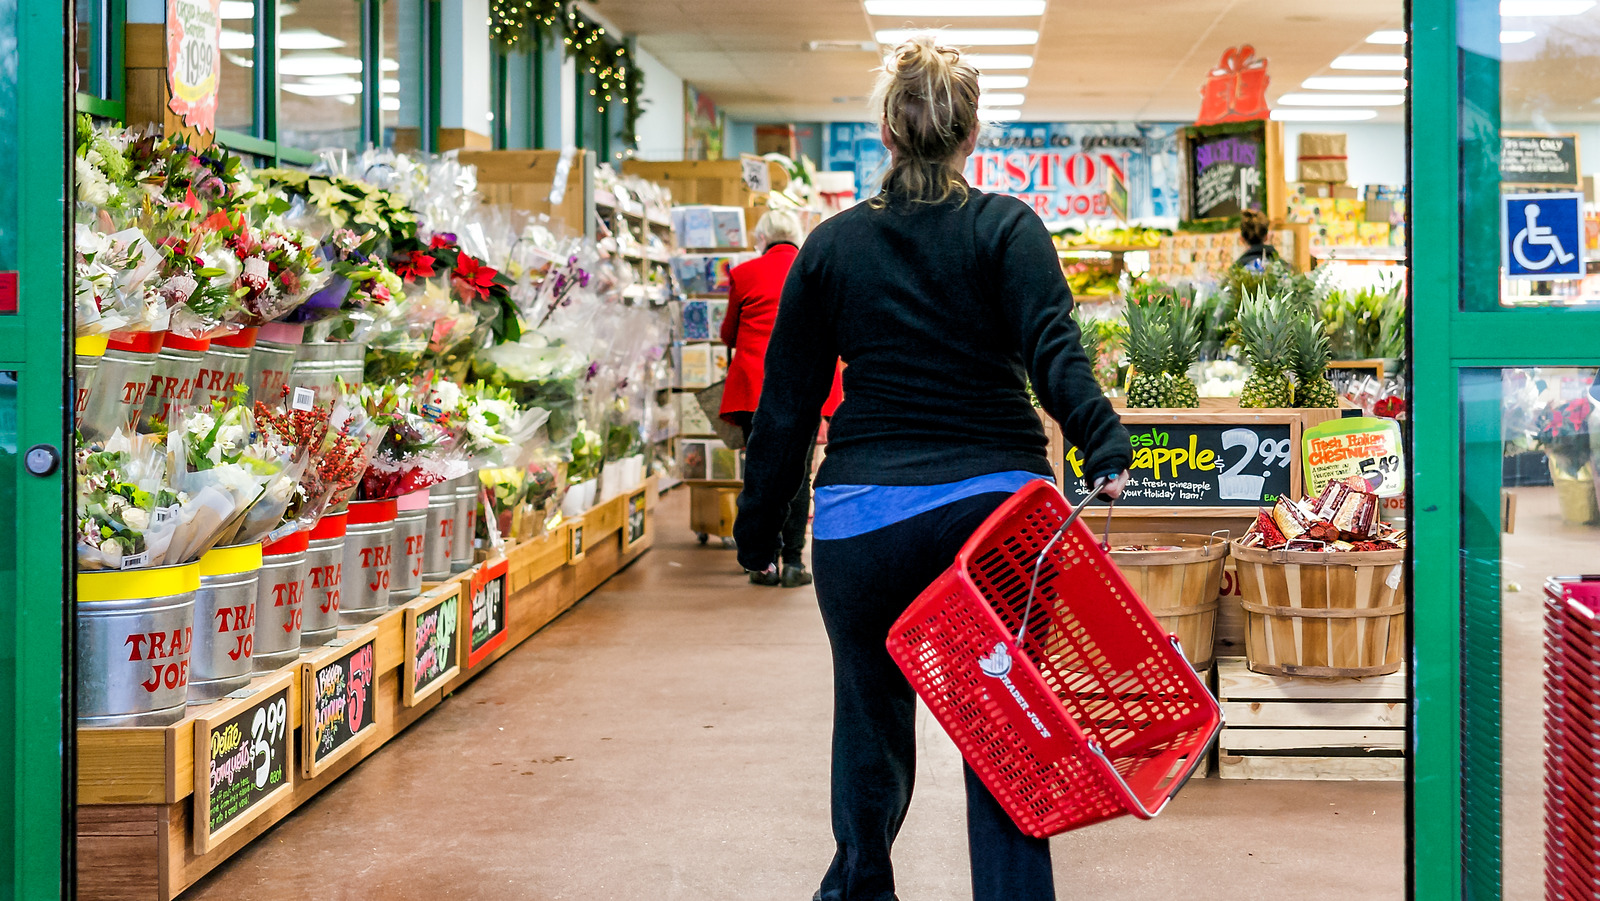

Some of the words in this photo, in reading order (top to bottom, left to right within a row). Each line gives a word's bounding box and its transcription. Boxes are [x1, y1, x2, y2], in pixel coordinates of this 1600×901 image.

[973, 152, 1130, 191] ESTON
[1057, 194, 1109, 217] JOE
[147, 375, 196, 399] TRA
[195, 368, 243, 391] TRA
[1129, 428, 1169, 446] esh
[1310, 437, 1342, 452] Fresh
[1309, 445, 1388, 466] CHESTNUTS
[1075, 487, 1091, 495] slic
[1122, 491, 1142, 500] your
[1143, 488, 1175, 500] Holiday
[1179, 489, 1204, 500] ham!
[1125, 478, 1139, 486] ats
[1142, 477, 1167, 488] fresh
[1169, 481, 1211, 493] pineapple
[1264, 493, 1279, 502] EAC
[1383, 498, 1405, 509] JOE
[358, 544, 391, 568] TRA
[308, 563, 342, 589] TRA
[272, 580, 304, 607] TRA
[214, 603, 256, 633] TRA
[124, 626, 193, 661] TRAD
[1000, 674, 1030, 711] TRADER
[1027, 710, 1051, 738] JOE'S
[211, 722, 242, 760] Petite
[249, 697, 286, 792] $3.99
[210, 740, 250, 795] Bouquets
